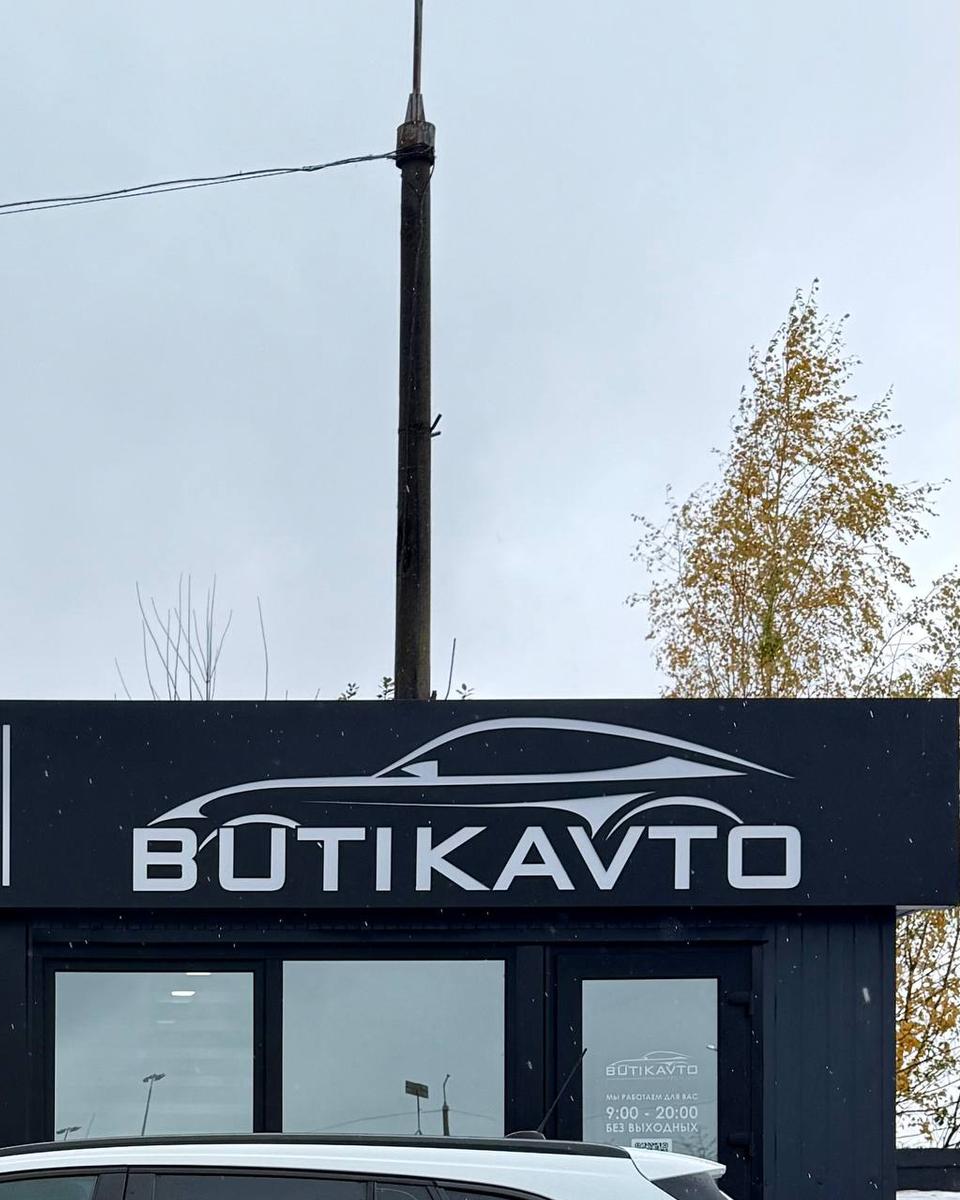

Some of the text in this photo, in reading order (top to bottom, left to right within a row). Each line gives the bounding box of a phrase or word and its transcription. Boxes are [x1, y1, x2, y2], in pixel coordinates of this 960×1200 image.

[132, 825, 802, 891] BUTIKAVTO
[606, 1065, 698, 1076] BUTIKAVTO
[606, 1106, 639, 1120] 9:00
[655, 1105, 698, 1119] 20:00
[606, 1123, 698, 1133] БЕЗ ВЫХОДНЫХ
